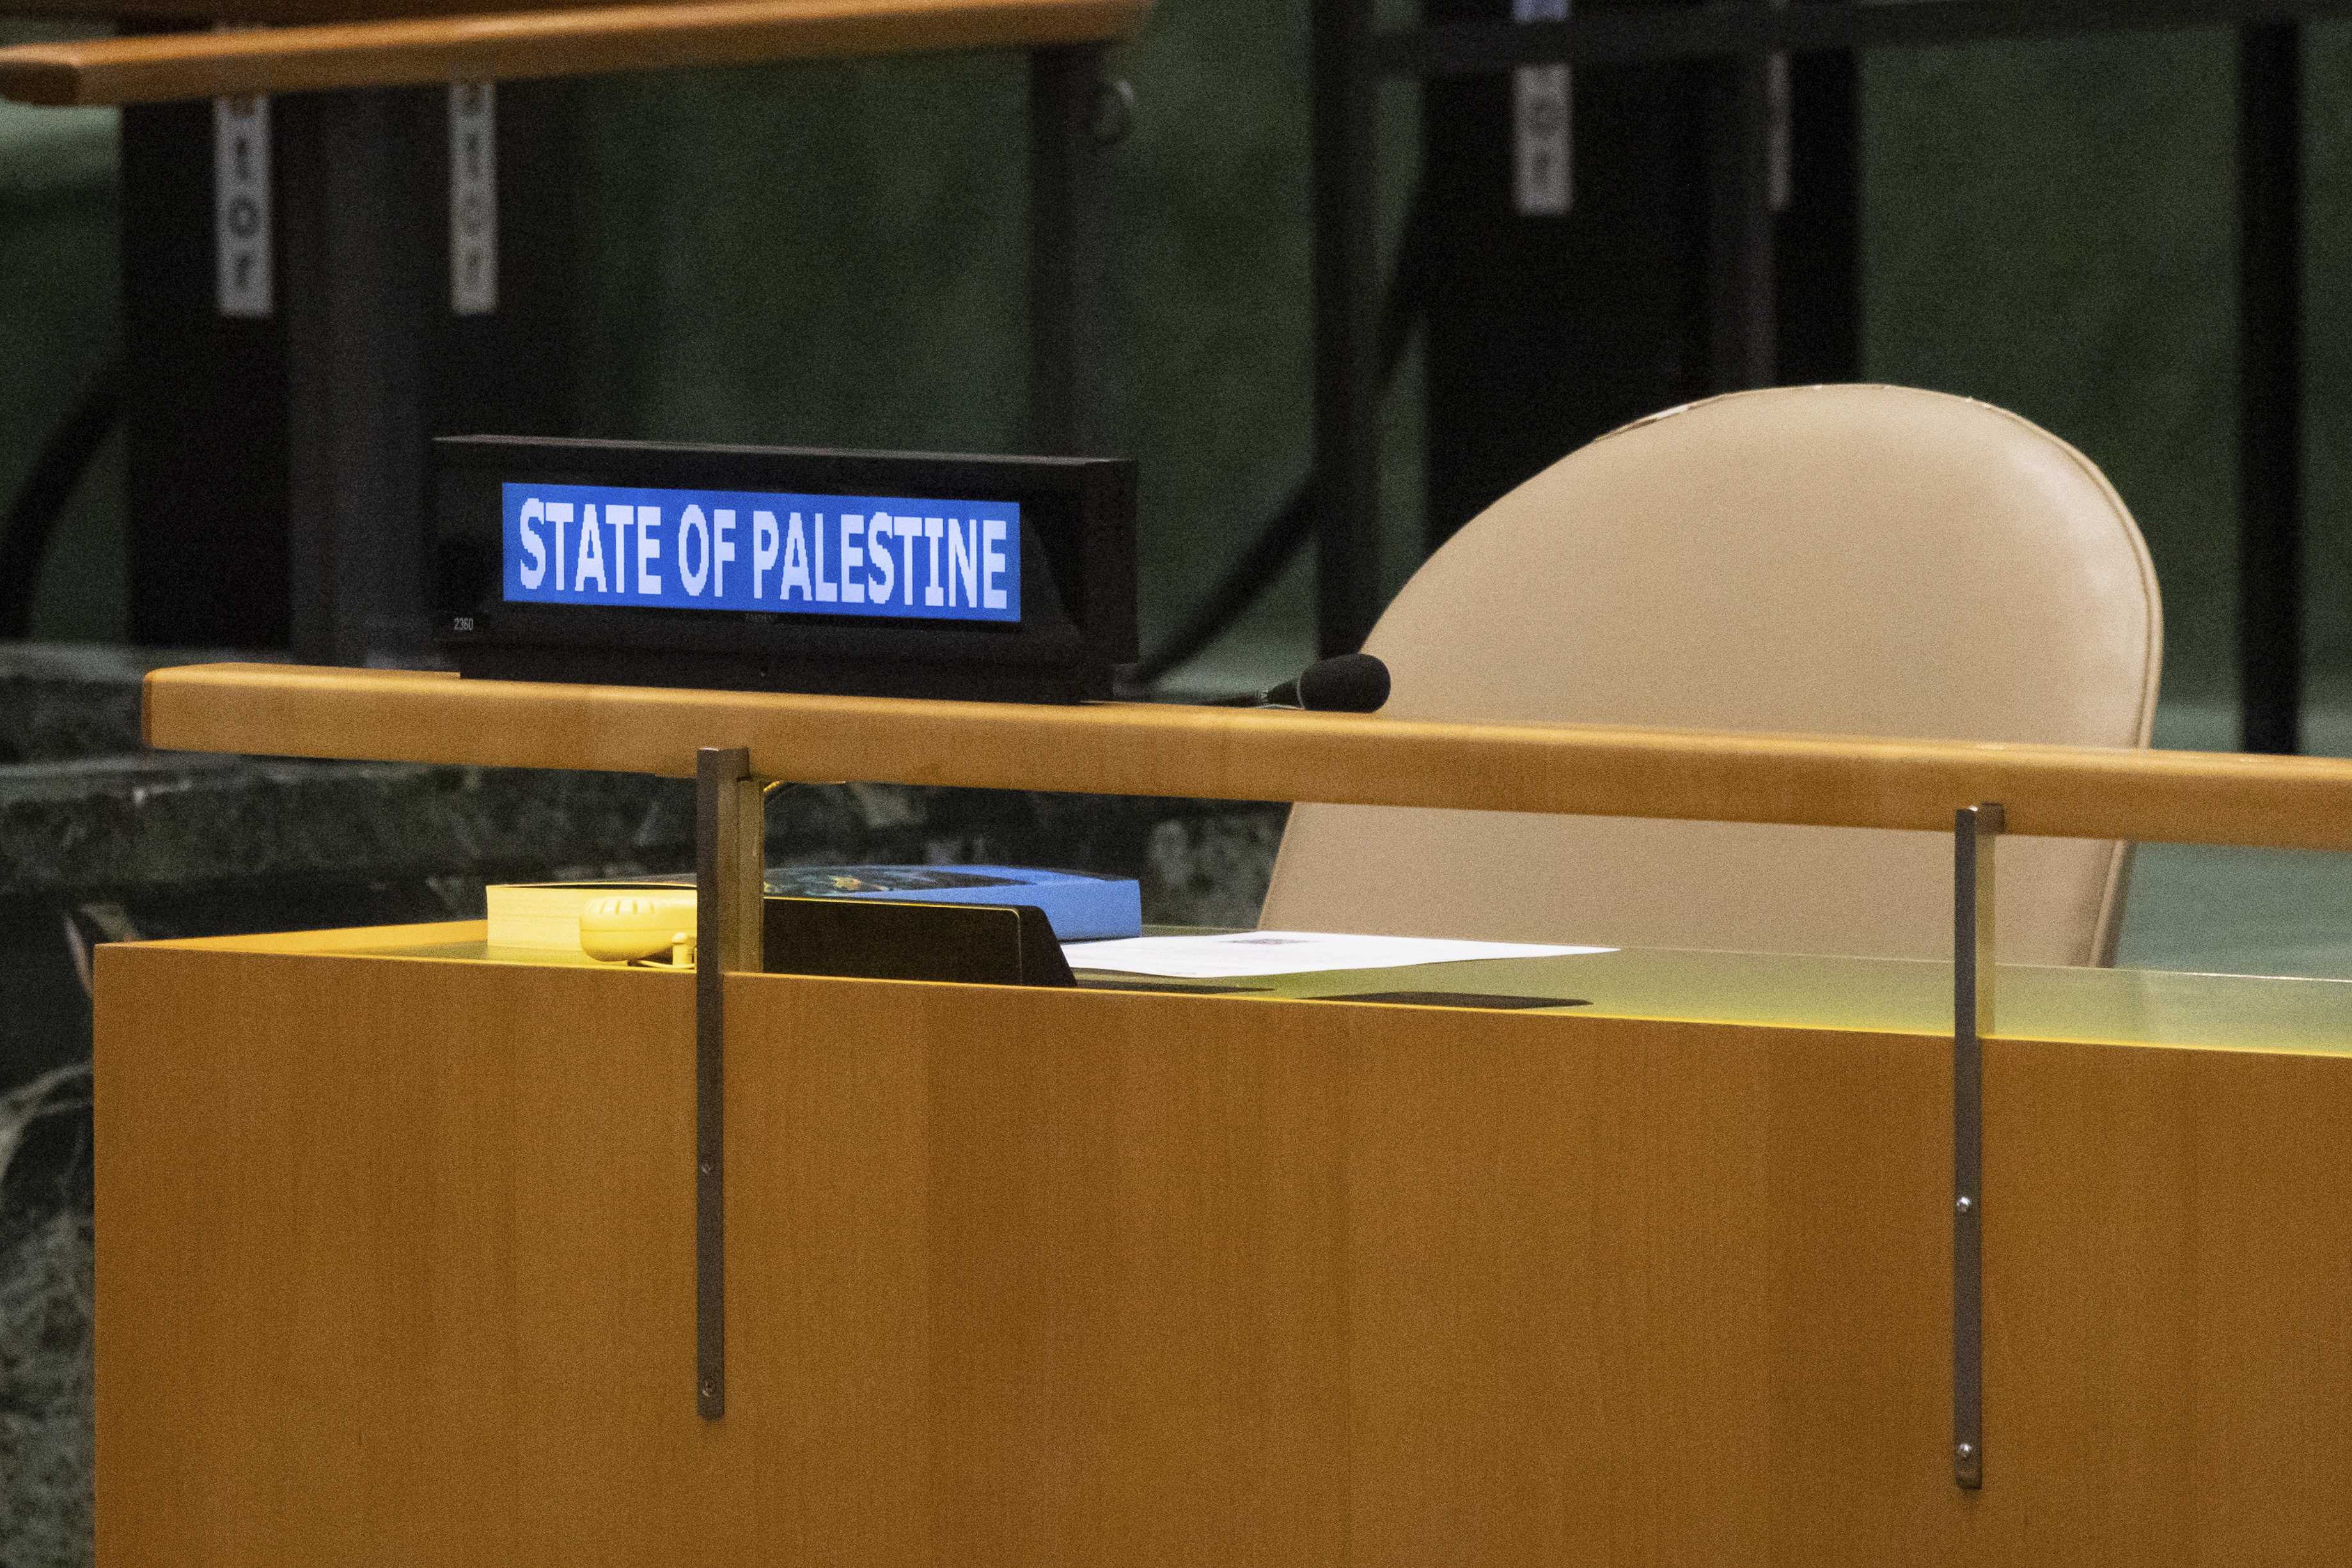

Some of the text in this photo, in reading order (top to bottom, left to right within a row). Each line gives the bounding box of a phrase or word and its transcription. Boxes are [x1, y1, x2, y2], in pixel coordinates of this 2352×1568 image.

[520, 498, 1007, 609] STATE OF PALESTINE
[453, 617, 474, 631] 2360
